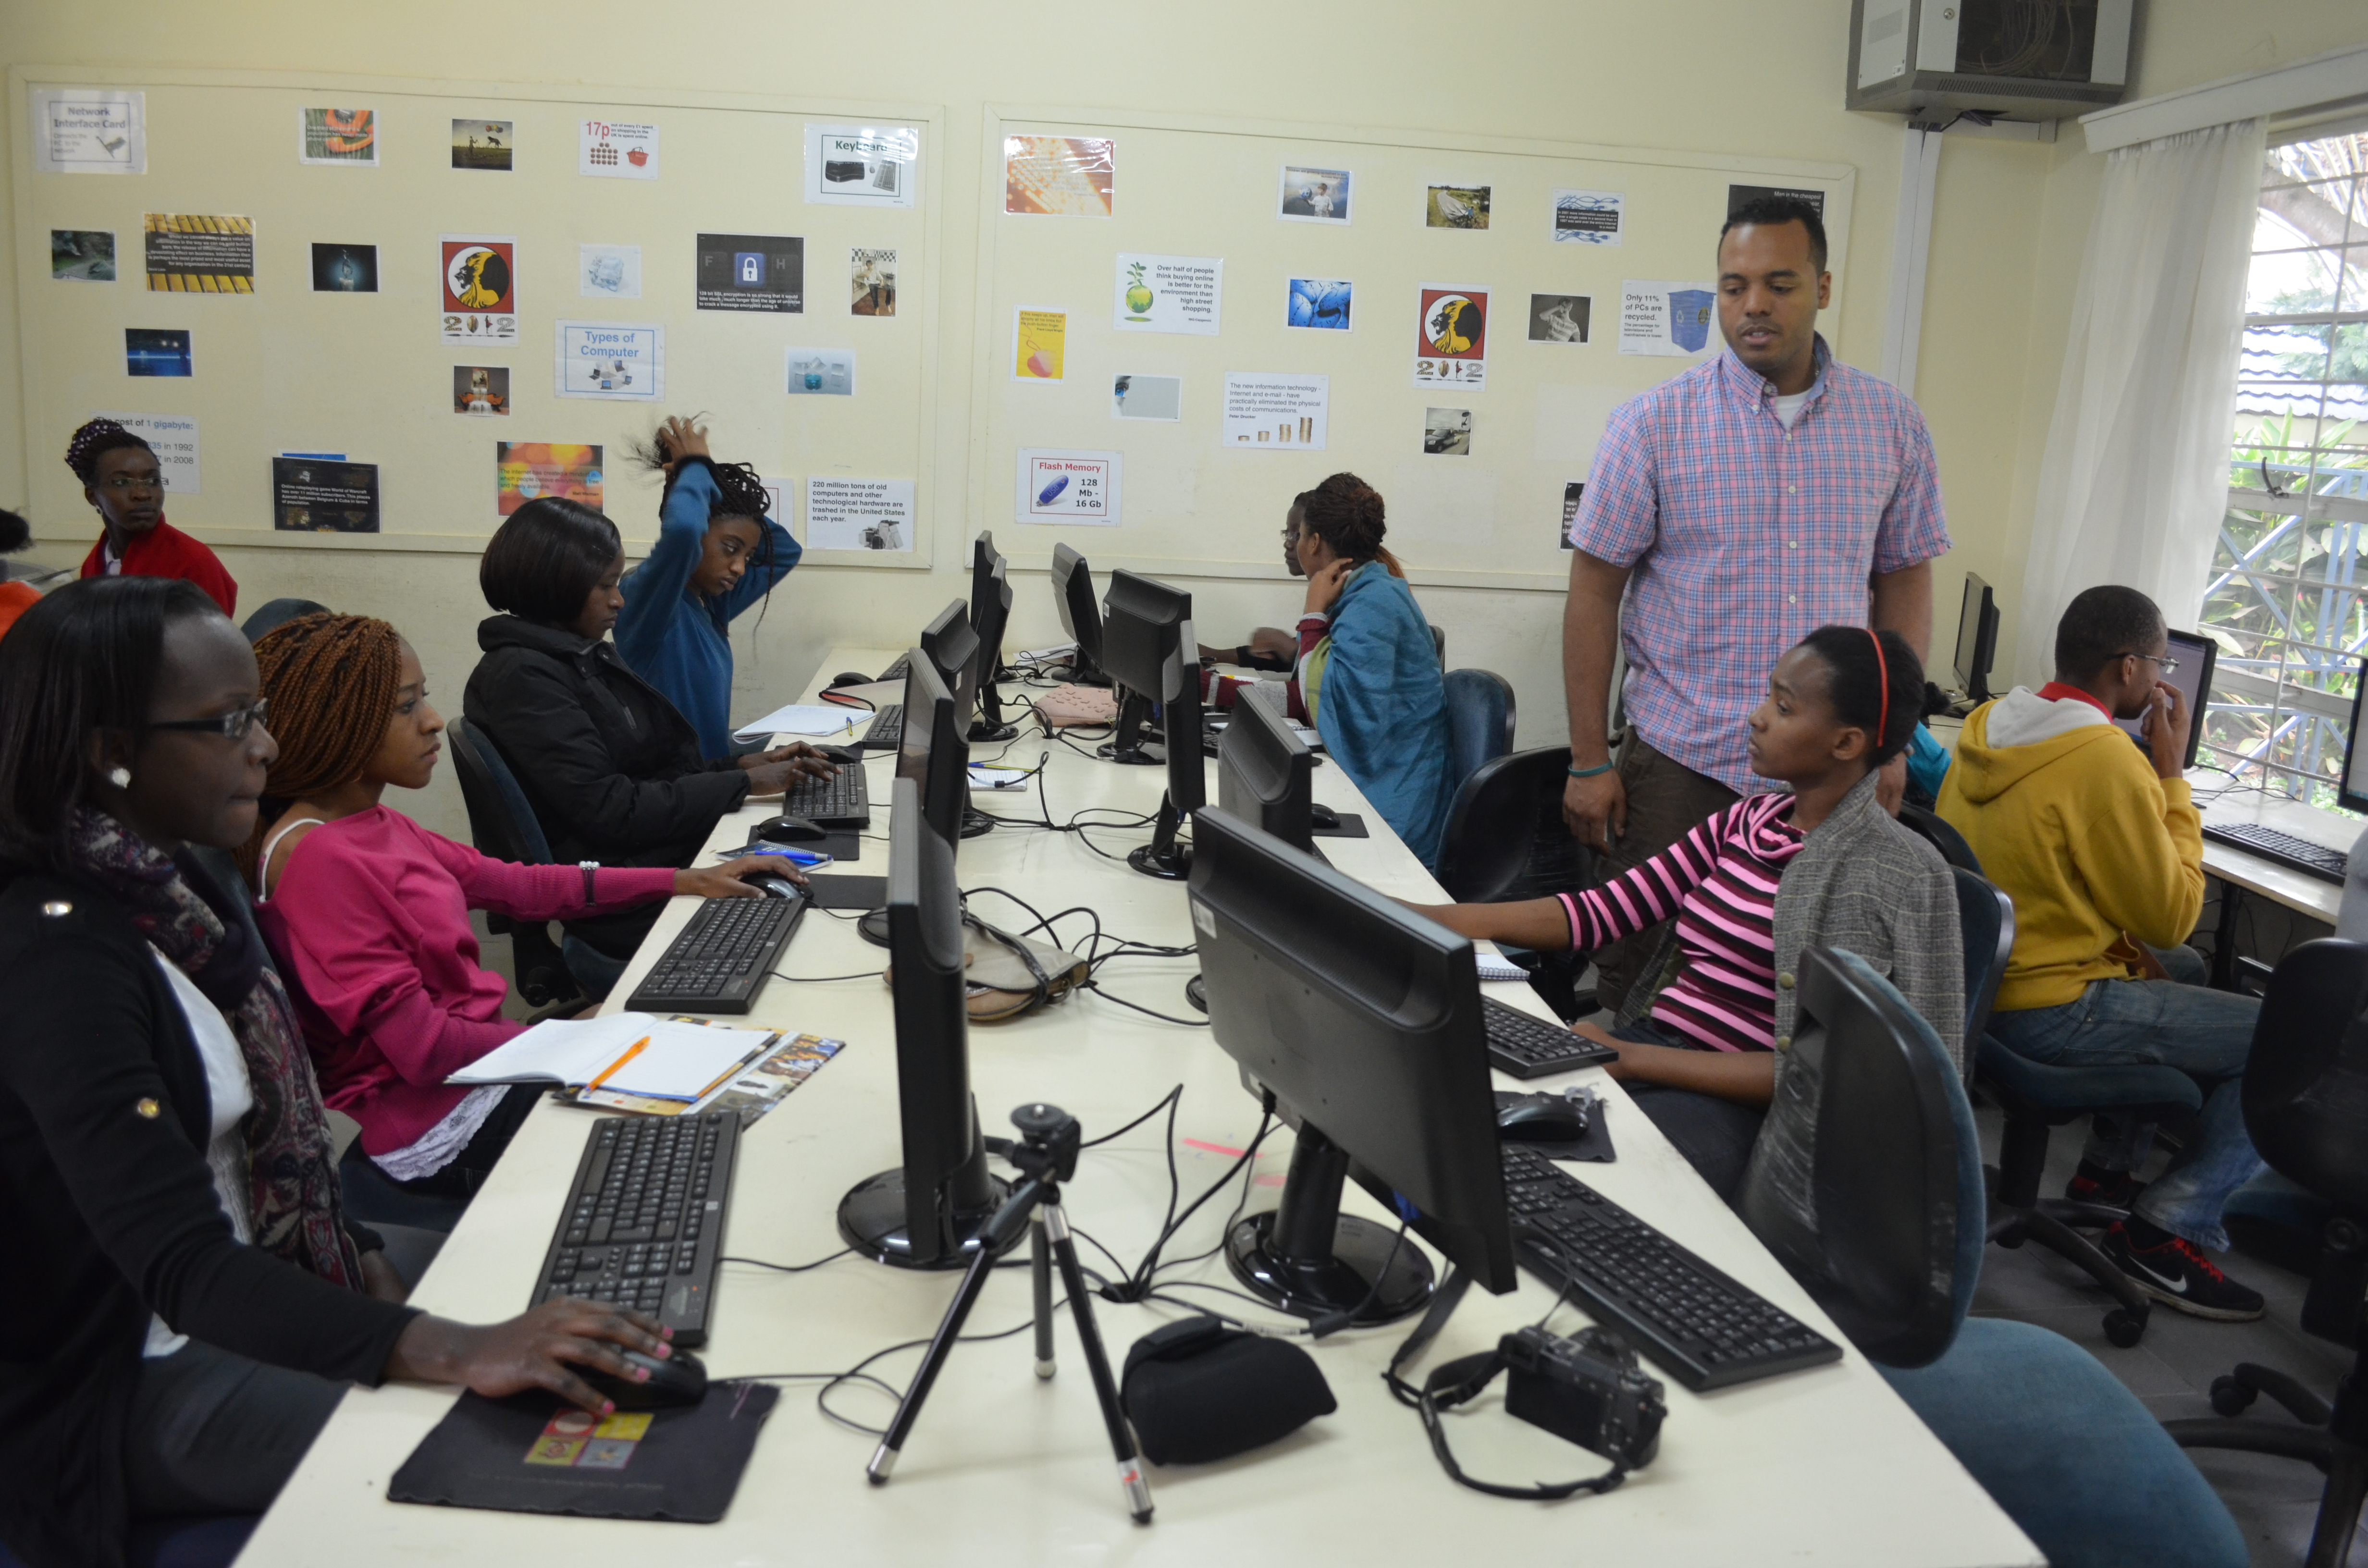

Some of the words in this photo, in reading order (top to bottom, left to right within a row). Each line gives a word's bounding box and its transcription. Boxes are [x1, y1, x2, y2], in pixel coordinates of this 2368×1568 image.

[54, 119, 100, 127] Interface
[587, 122, 610, 140] 17p
[705, 256, 713, 266] F
[776, 258, 785, 269] H
[585, 331, 619, 343] Types
[623, 333, 635, 343] of
[581, 346, 639, 358] Computer
[154, 421, 193, 430] gigabyte:
[1065, 464, 1100, 473] Memory
[1047, 485, 1059, 496] USB
